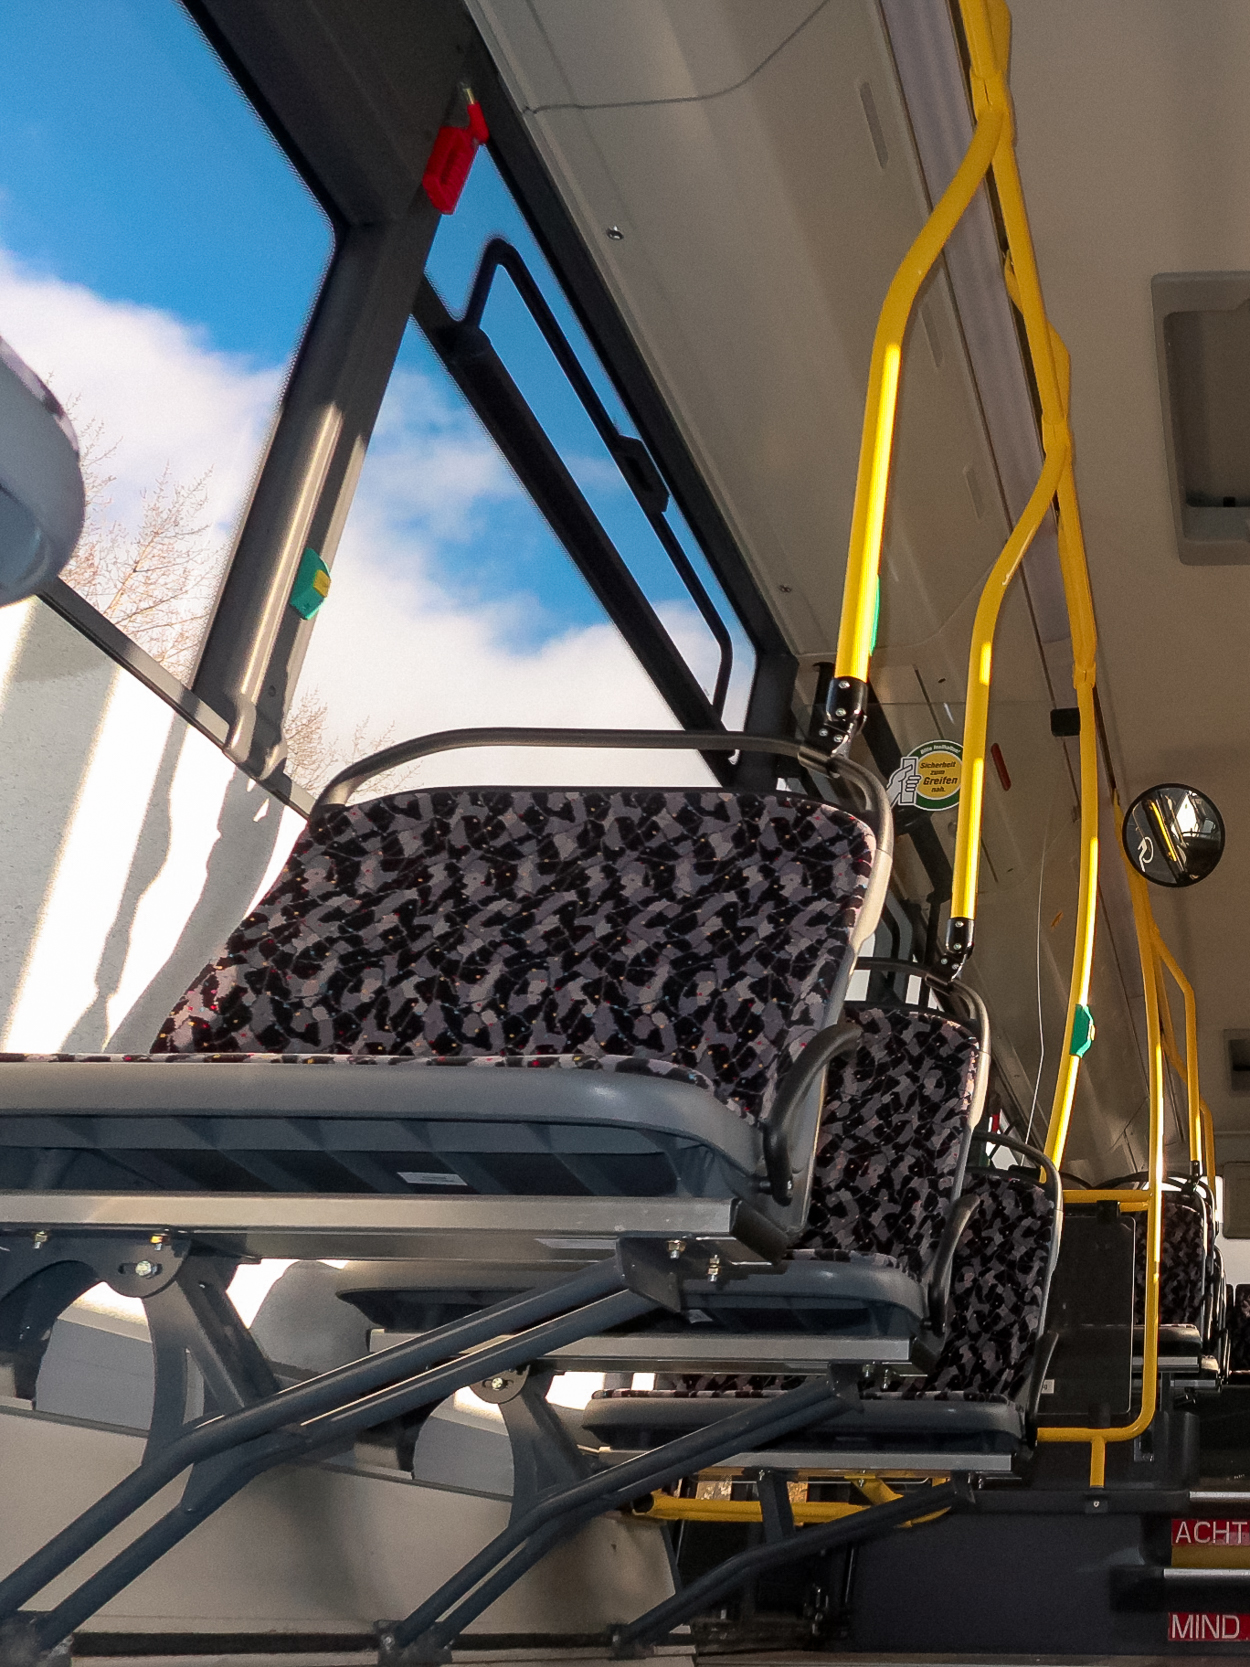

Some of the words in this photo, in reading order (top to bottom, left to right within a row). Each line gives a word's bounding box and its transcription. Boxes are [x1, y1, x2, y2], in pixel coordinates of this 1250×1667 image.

[920, 761, 956, 769] Sicherheit
[923, 777, 958, 785] Greifen
[1171, 1614, 1240, 1640] MIND
